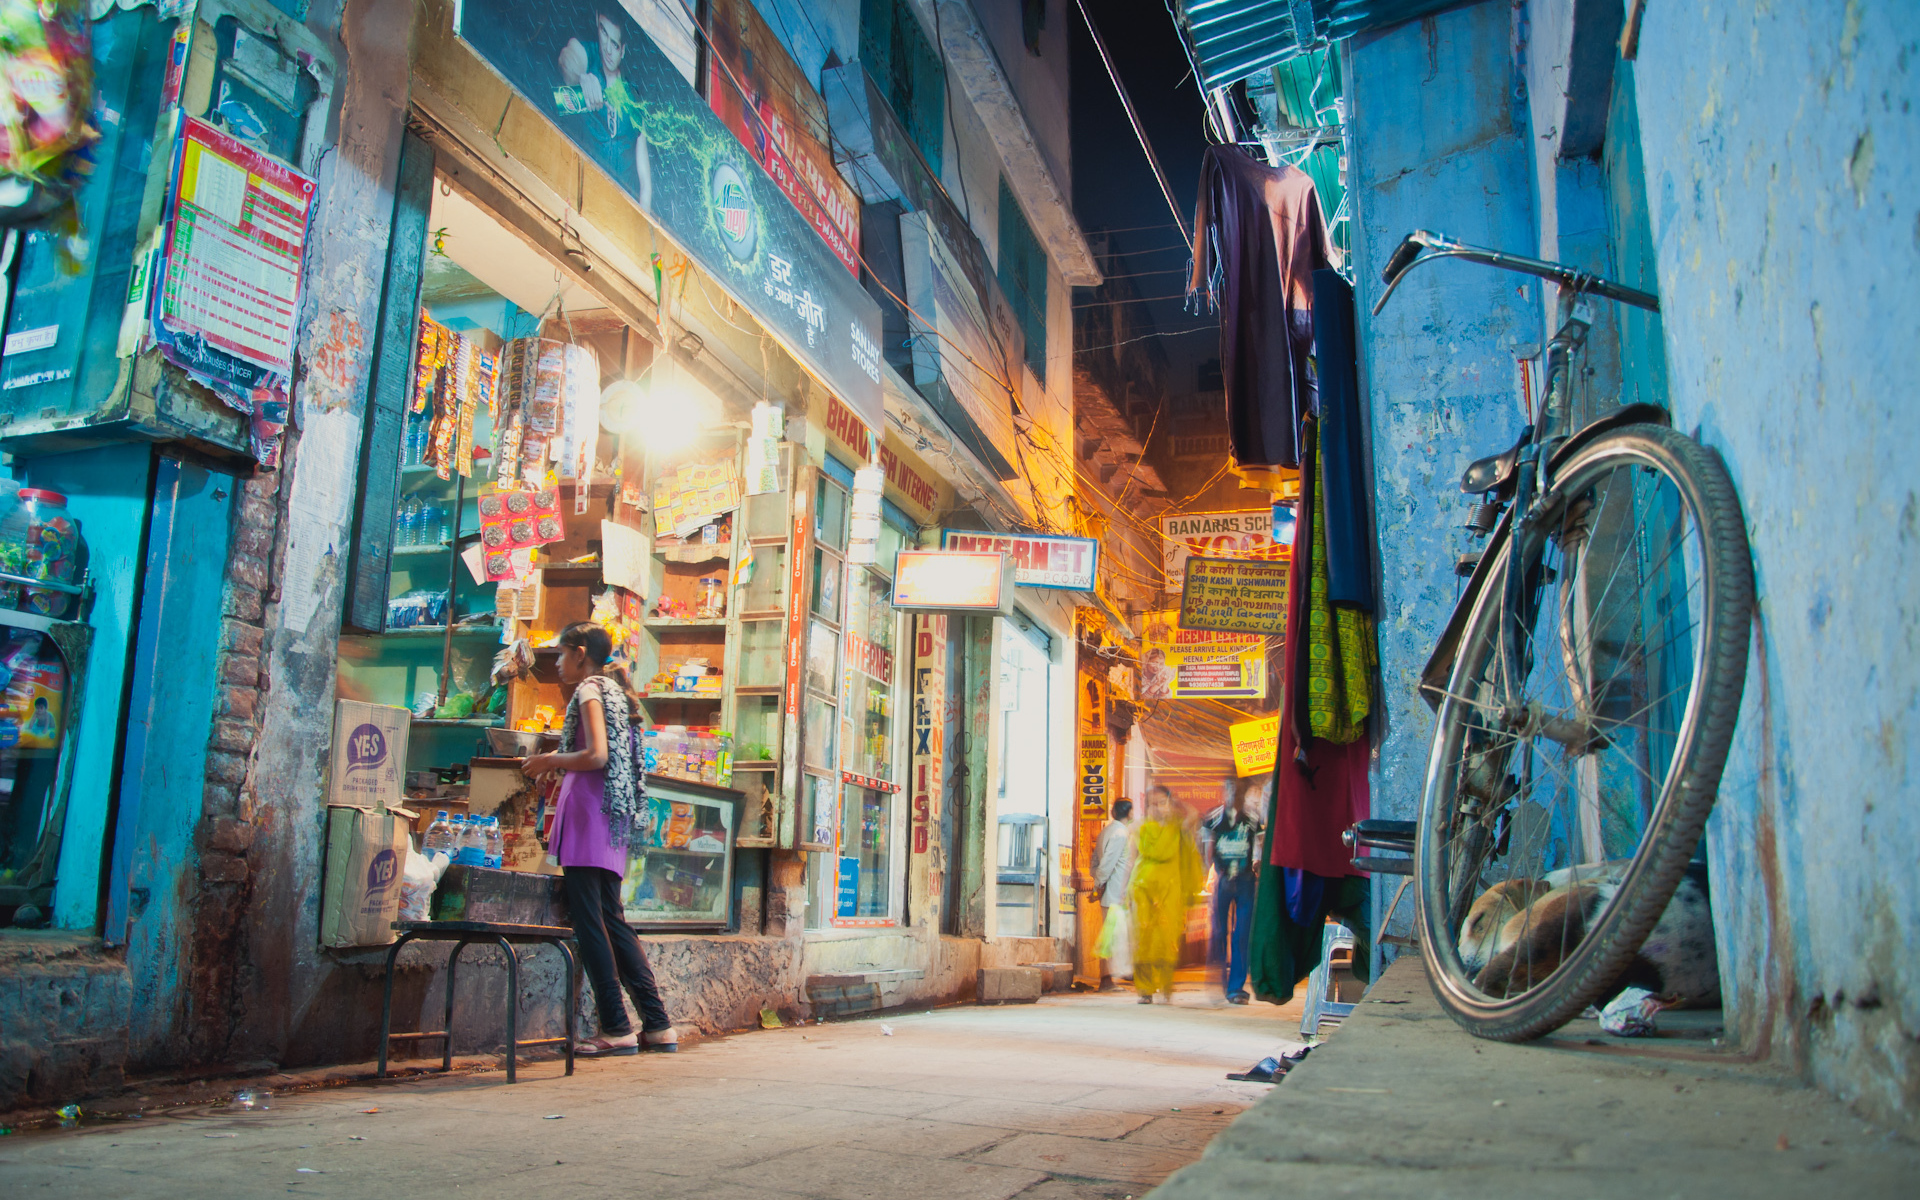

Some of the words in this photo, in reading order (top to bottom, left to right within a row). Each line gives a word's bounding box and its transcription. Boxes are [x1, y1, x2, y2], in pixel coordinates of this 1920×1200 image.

[771, 158, 798, 199] FULL
[822, 222, 855, 269] MASALA
[768, 252, 793, 287] डर
[764, 277, 774, 298] के
[774, 286, 794, 310] आगे
[794, 290, 826, 333] जीत
[850, 321, 880, 365] SANJAY
[851, 343, 880, 385] STORES
[826, 396, 897, 484] BHAVSH
[897, 460, 939, 513] INTERNET
[1169, 517, 1240, 535] BANARAS
[1244, 516, 1273, 532] SCH
[1073, 576, 1091, 586] FAX
[1190, 574, 1208, 584] SHRI
[1210, 576, 1233, 586] KASHI
[1236, 578, 1286, 588] VISHWANATH
[1195, 562, 1207, 574] श्री
[1209, 564, 1235, 575] काशी
[1169, 645, 1192, 654] PLEASE
[1193, 645, 1216, 653] ARRIVE
[1216, 645, 1228, 653] ALL
[1175, 630, 1213, 644] HEENA
[1215, 631, 1261, 644] CENTRE
[1183, 655, 1204, 663] HEENA
[1215, 655, 1240, 663] CENTRE
[353, 733, 380, 760] YES
[1081, 749, 1106, 759] SCHOOL
[1082, 764, 1106, 805] YOGA
[913, 764, 931, 855] ISD
[374, 857, 395, 884] YES
